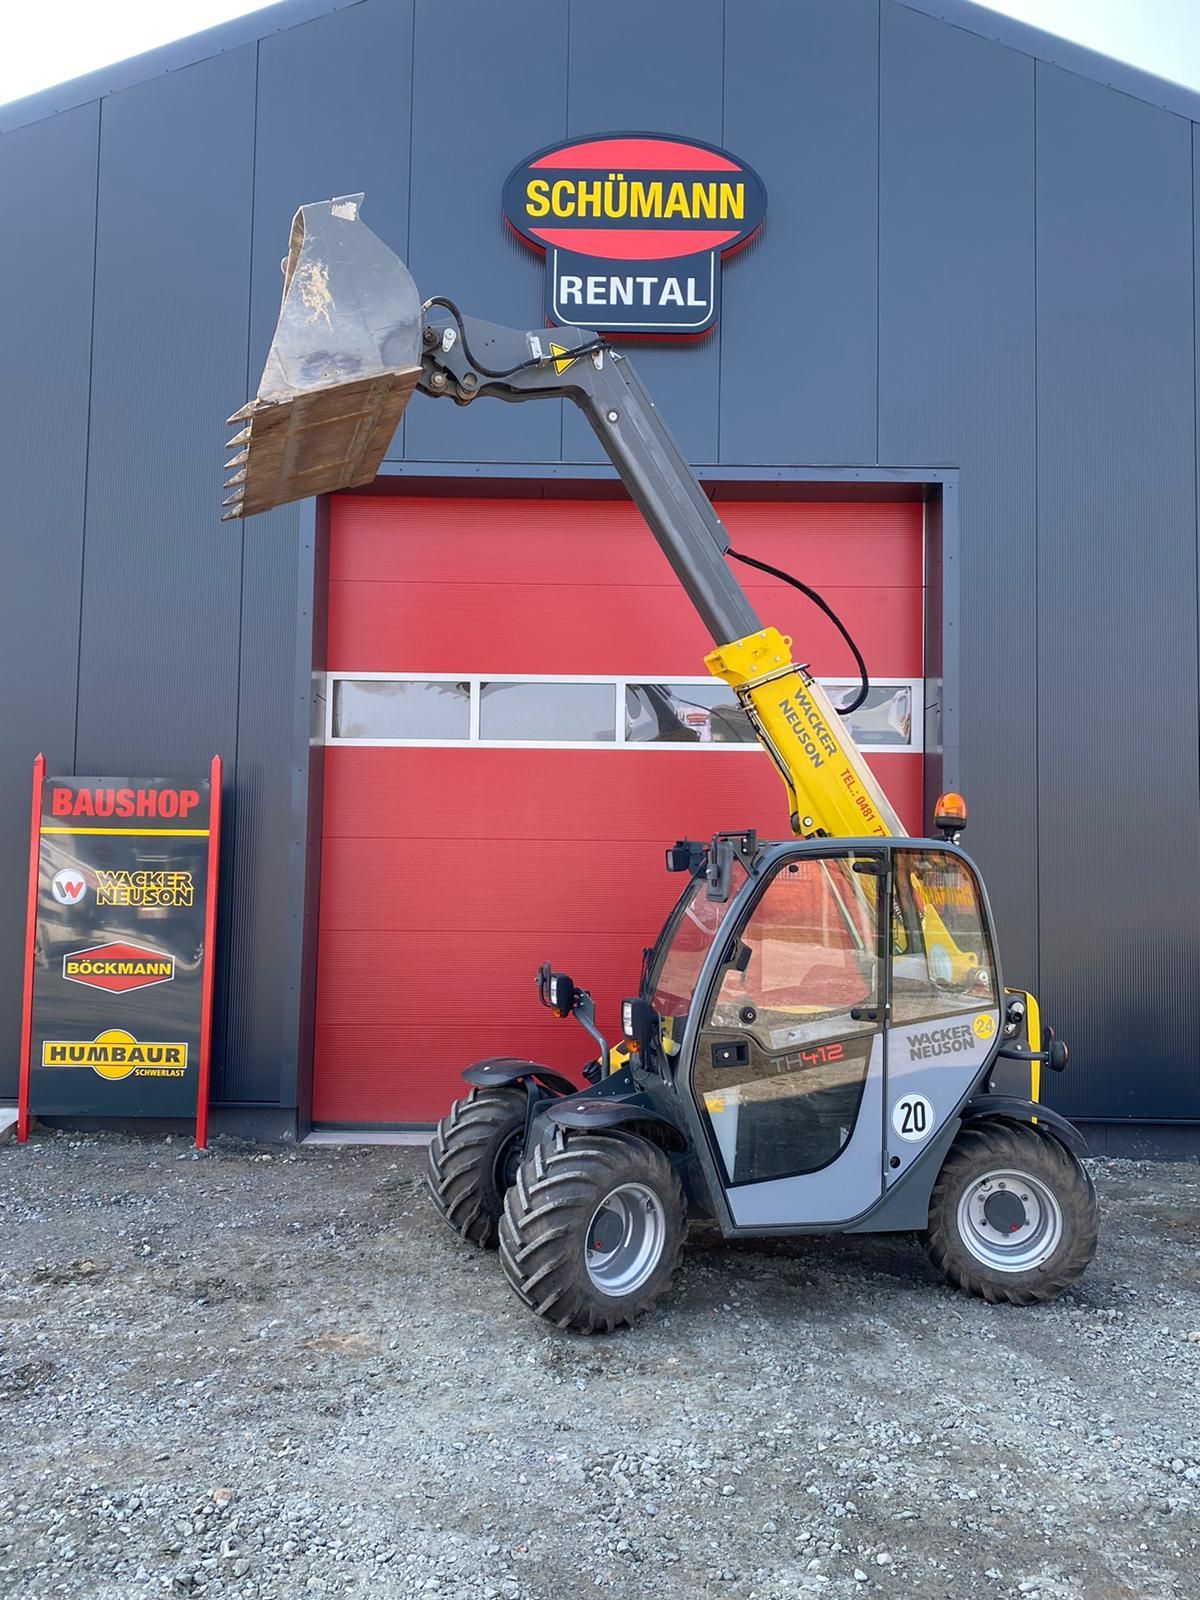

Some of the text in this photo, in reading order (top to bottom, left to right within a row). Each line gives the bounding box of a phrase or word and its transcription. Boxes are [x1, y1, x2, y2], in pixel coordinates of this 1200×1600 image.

[525, 173, 745, 219] SCHÜMANN
[559, 275, 707, 306] RENTAL
[778, 699, 825, 769] NEUSON
[794, 687, 837, 757] WACKER
[52, 788, 200, 818] BAUSHOP
[840, 768, 859, 797] TEL.:
[855, 795, 876, 822] 0481
[95, 871, 194, 889] WACKER
[96, 887, 193, 906] NEUSON
[66, 960, 171, 975] BÖCKMANN
[906, 1025, 972, 1047] WACKER
[976, 1019, 994, 1033] 24
[50, 1046, 180, 1063] HUMBAUR
[770, 1043, 844, 1072] TH412
[909, 1037, 975, 1061] NEUSON
[134, 1068, 185, 1077] SCHWERLAST
[900, 1101, 926, 1133] 20
